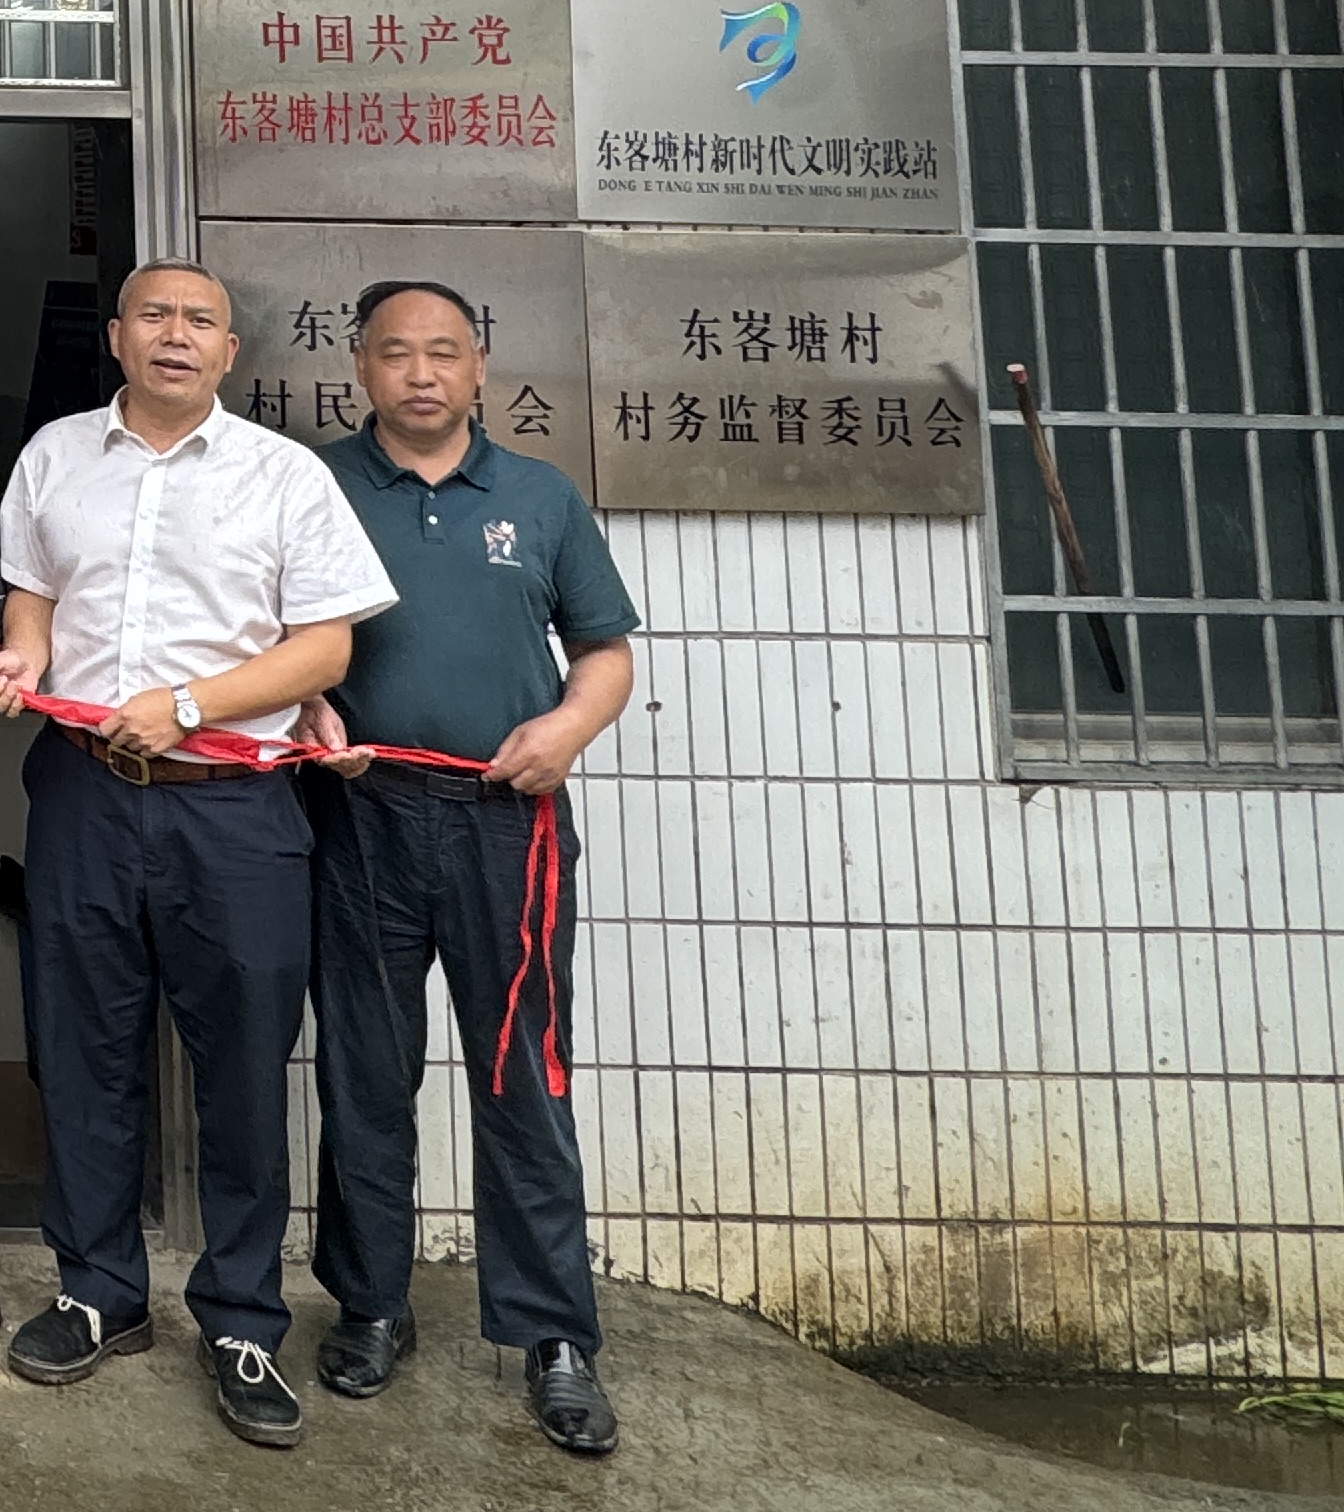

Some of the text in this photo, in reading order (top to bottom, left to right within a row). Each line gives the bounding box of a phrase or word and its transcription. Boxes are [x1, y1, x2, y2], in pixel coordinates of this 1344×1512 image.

[261, 10, 512, 66] 中国共产党
[597, 178, 940, 202] DONG E TANG XIN SHI DAI WEN MING SHI JIAN ZHAN
[245, 378, 555, 436] 村民会
[613, 390, 966, 448] 村务监督委员会
